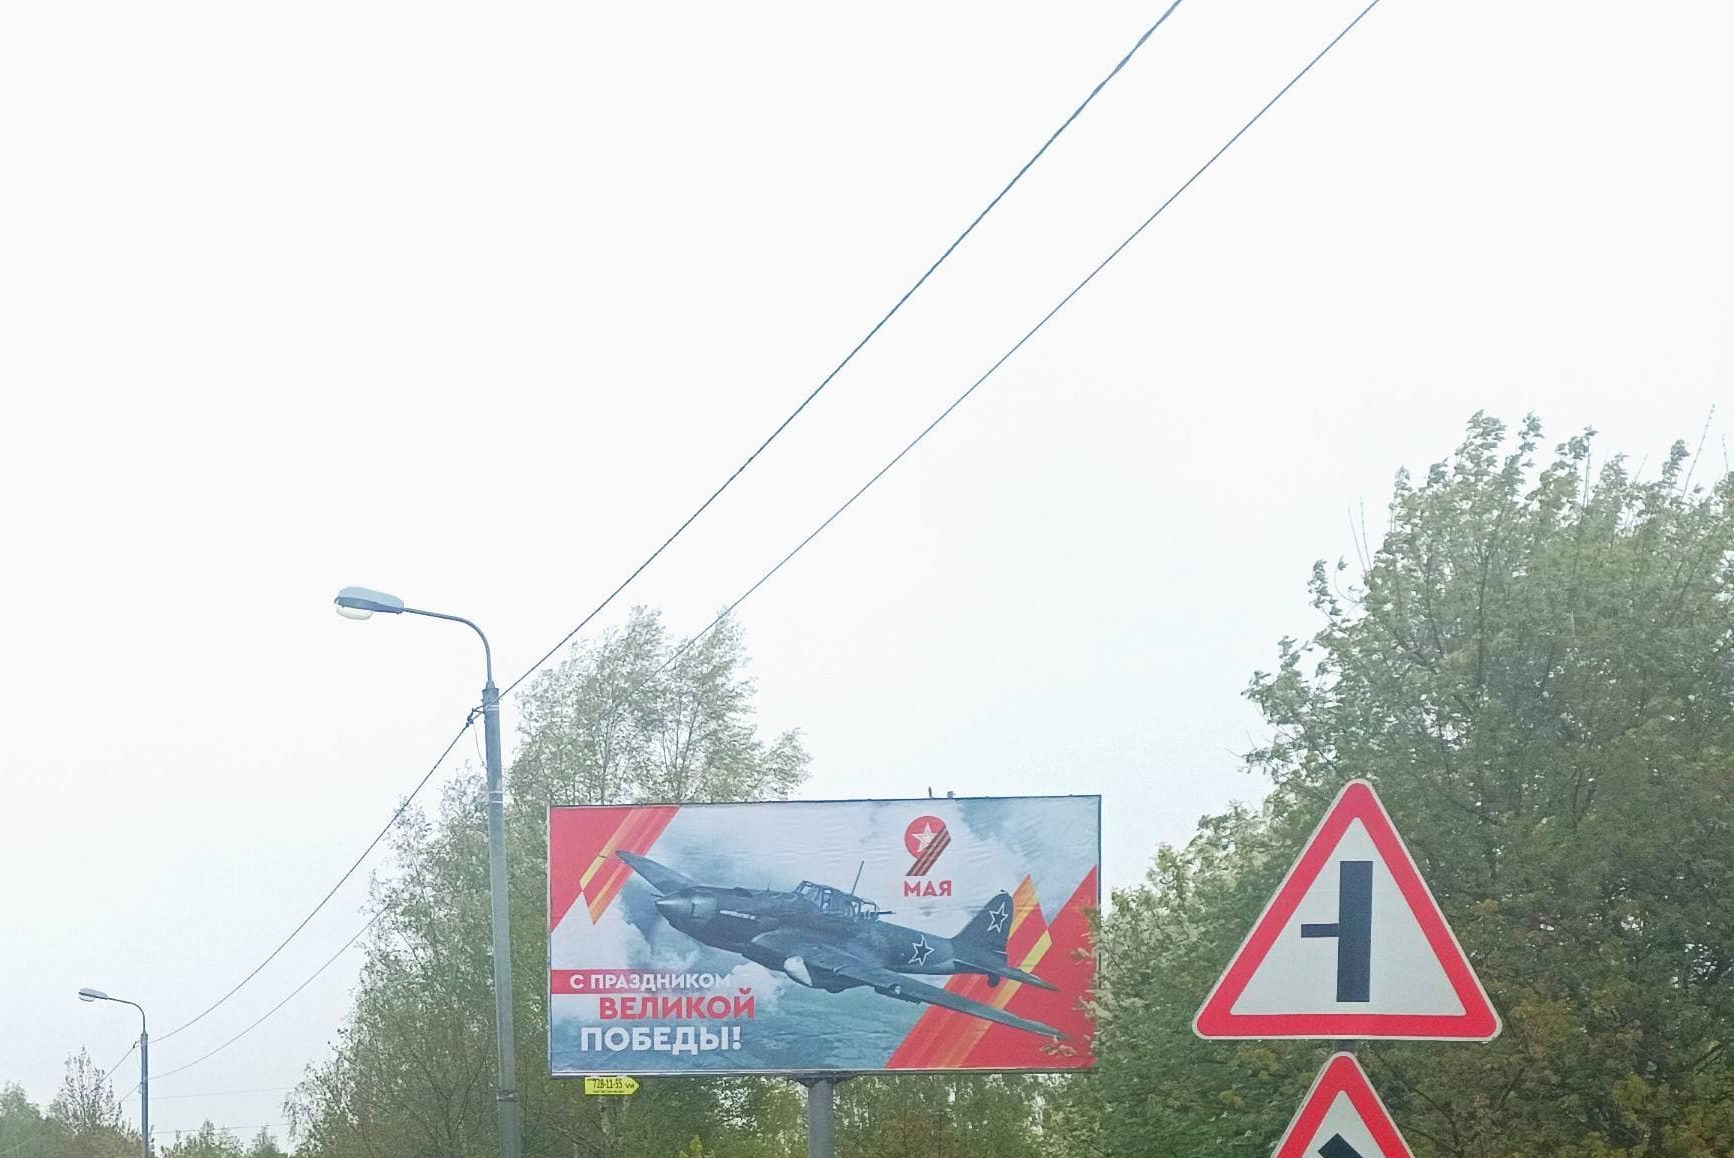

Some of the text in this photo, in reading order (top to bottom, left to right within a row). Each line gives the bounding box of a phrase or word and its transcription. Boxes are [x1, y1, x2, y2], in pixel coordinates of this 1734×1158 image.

[903, 879, 952, 897] МАЯ
[569, 973, 732, 992] С ПРАЗДНИКОМ
[599, 987, 756, 1020] ВЕЛИКОЙ
[580, 1026, 743, 1056] ПОБЕДЫ!
